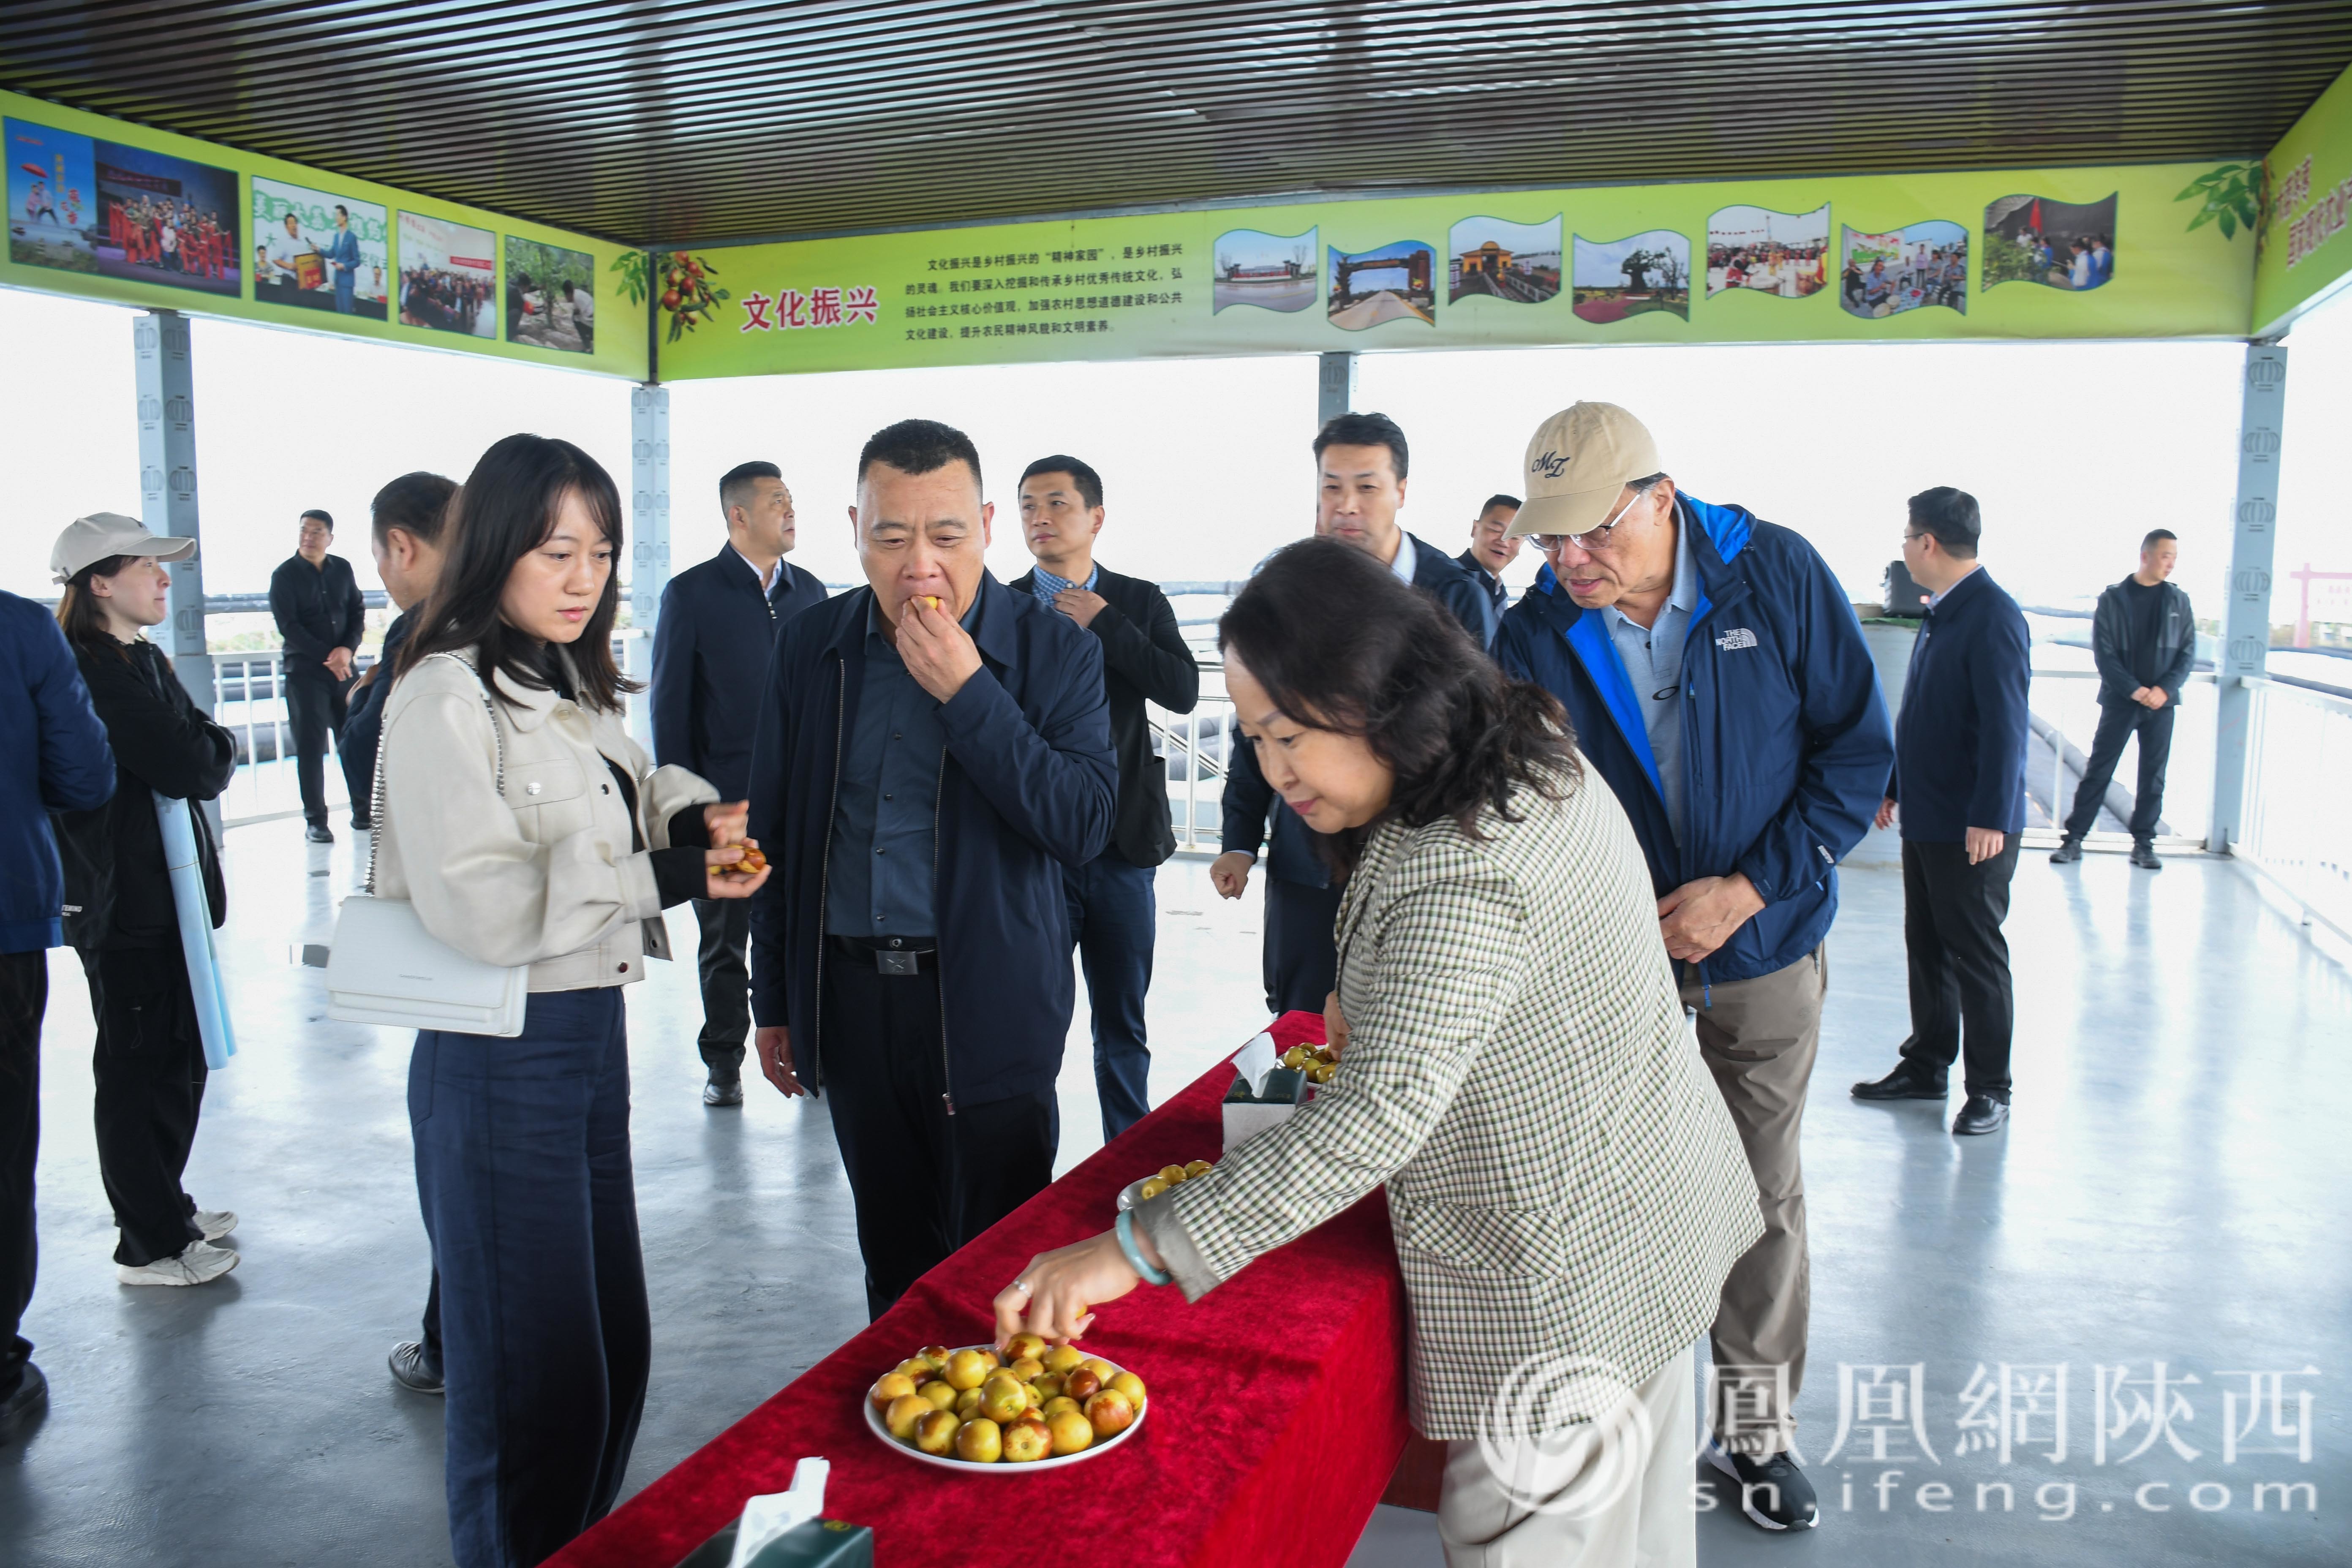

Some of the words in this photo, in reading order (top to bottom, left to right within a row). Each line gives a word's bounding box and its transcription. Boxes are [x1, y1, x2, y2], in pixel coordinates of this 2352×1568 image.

[742, 287, 878, 331] 文化振兴
[1715, 636, 1742, 646] NORTH
[1723, 642, 1744, 651] FACE
